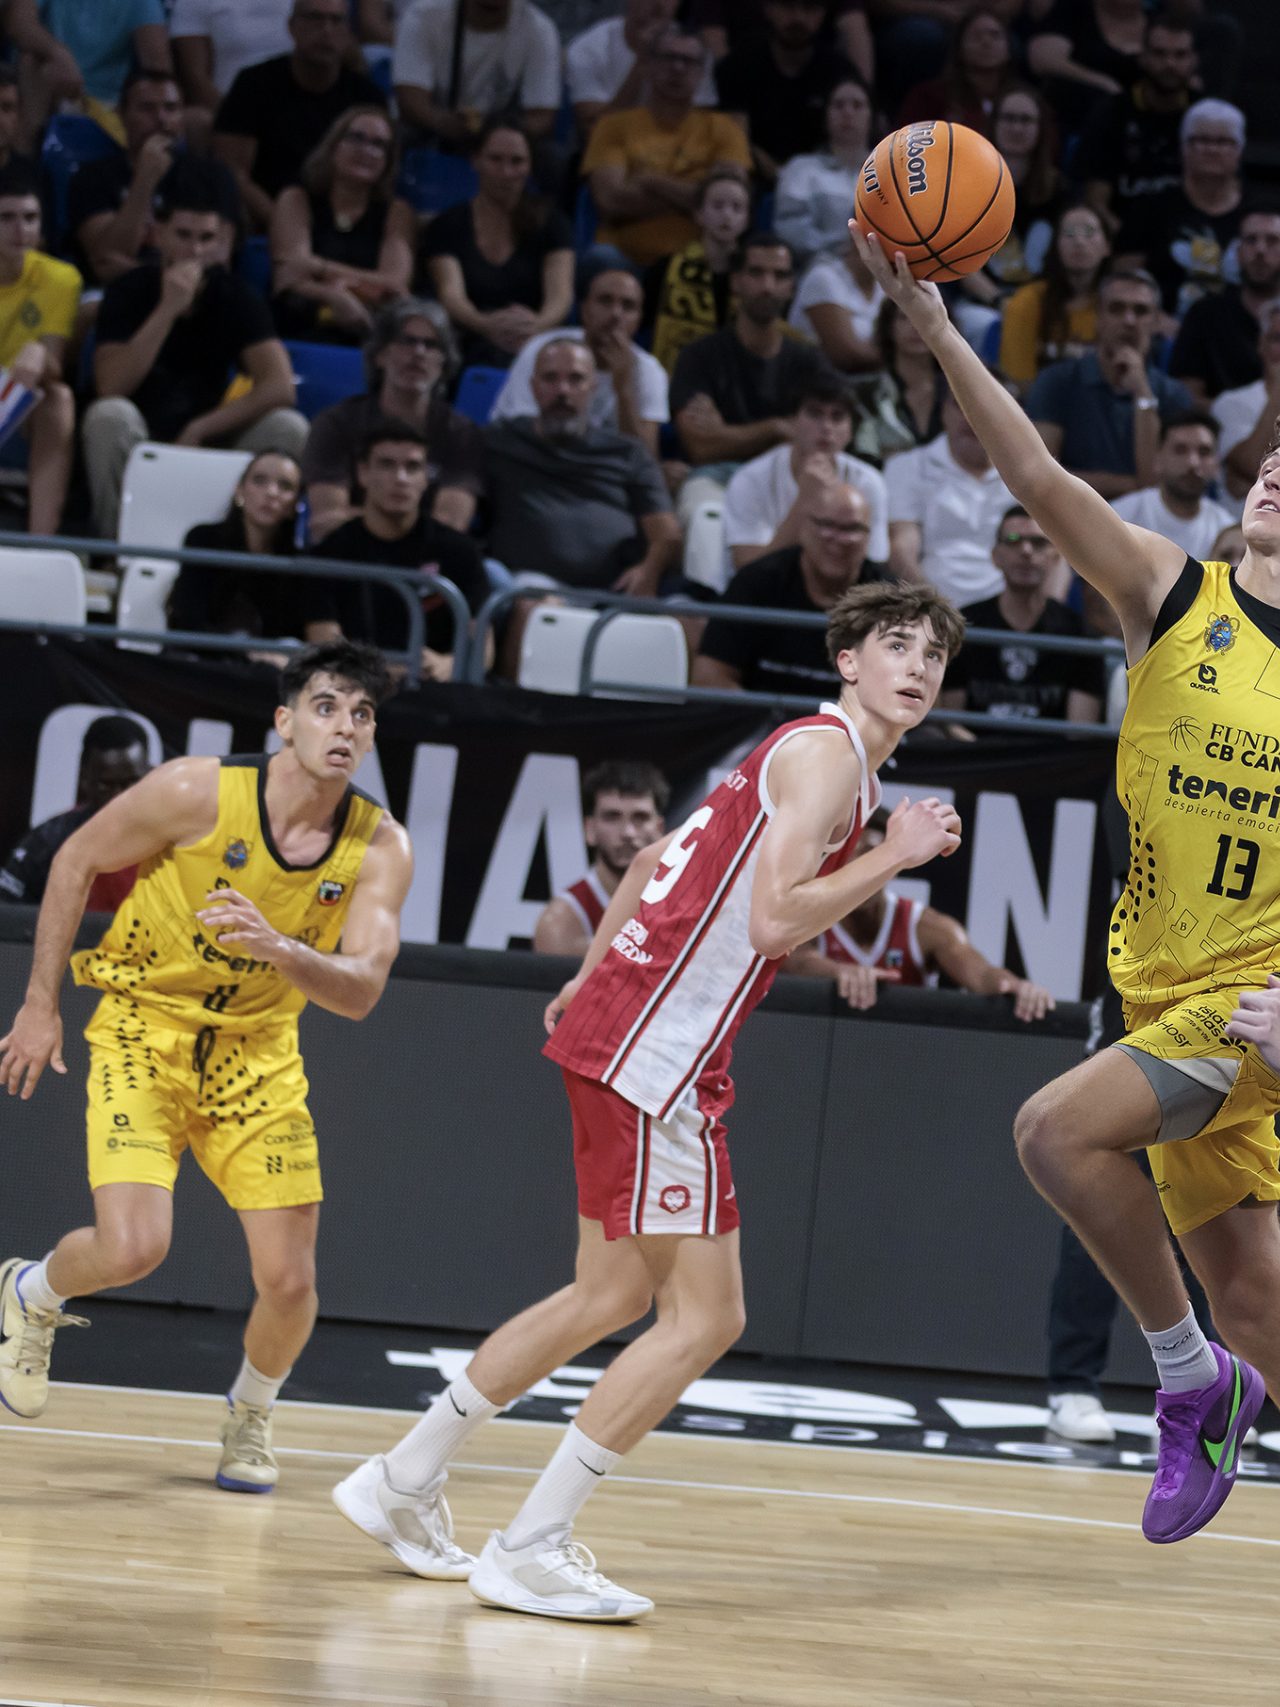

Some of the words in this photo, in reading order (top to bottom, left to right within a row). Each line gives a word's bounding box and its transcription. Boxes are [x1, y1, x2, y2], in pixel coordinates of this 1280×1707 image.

[1205, 742, 1234, 762] CB
[1165, 796, 1231, 821] despierta
[1206, 833, 1261, 901] 13
